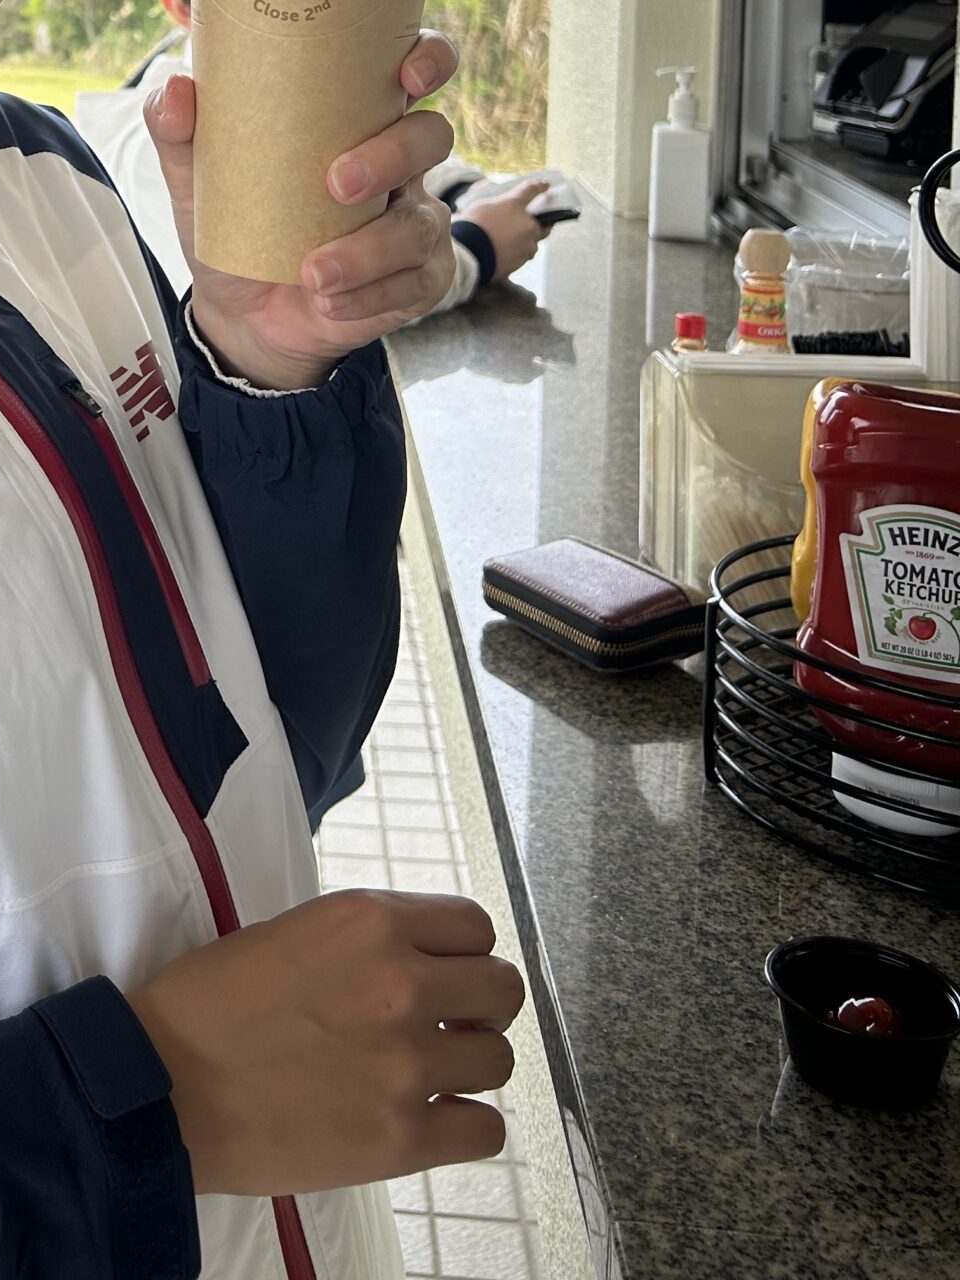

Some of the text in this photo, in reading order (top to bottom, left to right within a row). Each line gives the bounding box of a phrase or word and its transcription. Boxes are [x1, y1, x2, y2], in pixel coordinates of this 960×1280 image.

[253, 0, 332, 22] Close 2nd
[888, 526, 960, 557] HEINZ
[915, 551, 935, 560] 1869
